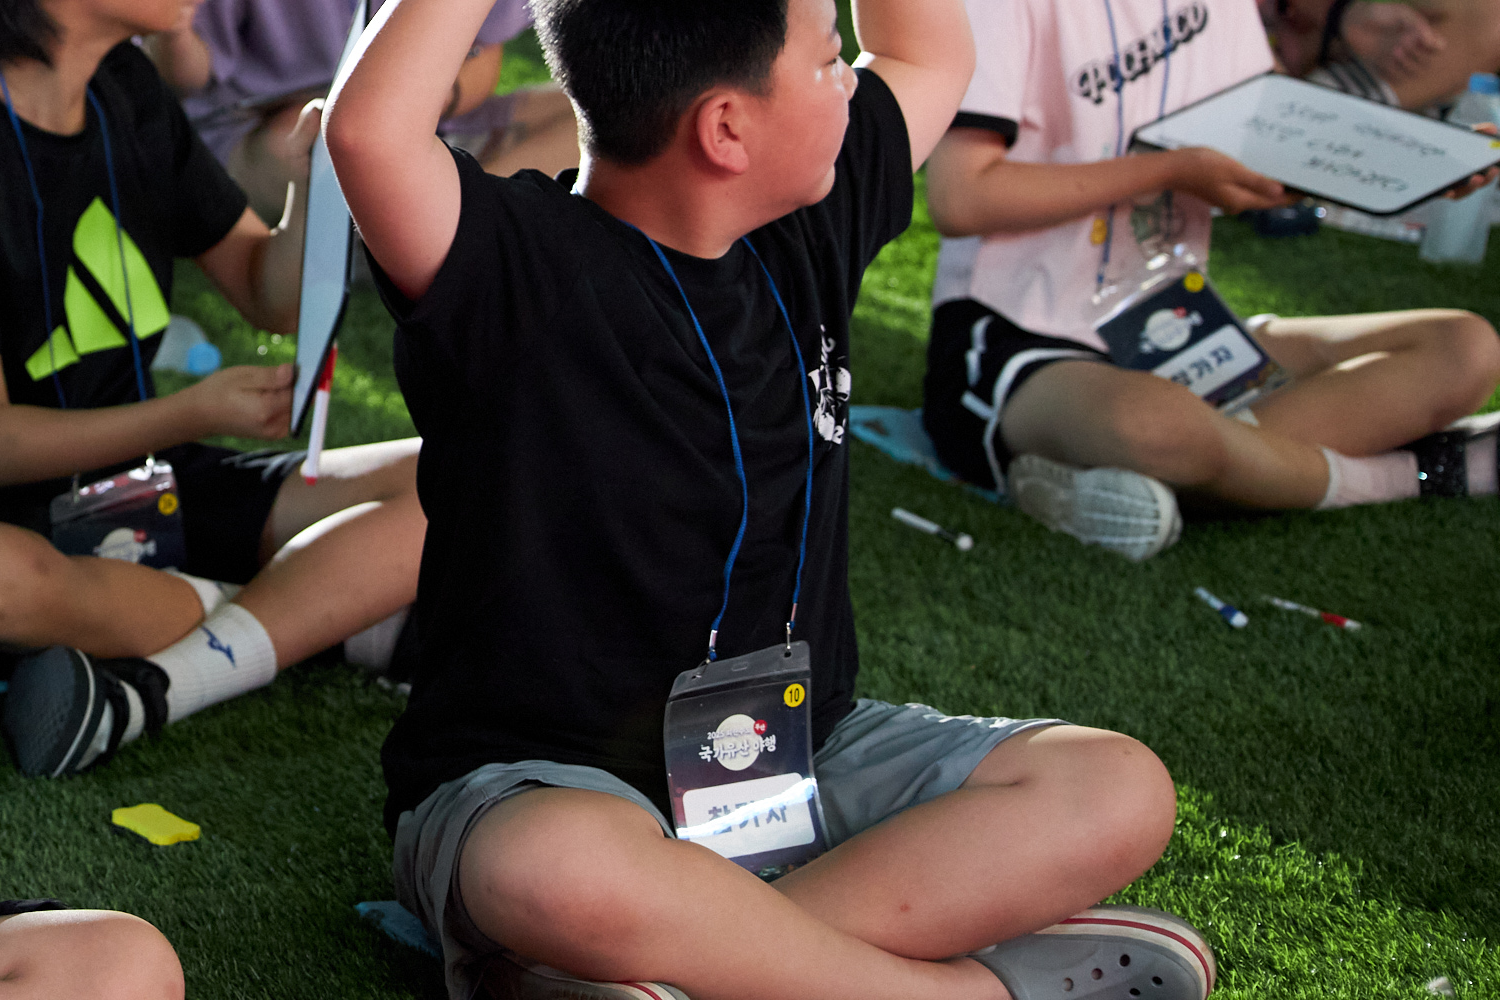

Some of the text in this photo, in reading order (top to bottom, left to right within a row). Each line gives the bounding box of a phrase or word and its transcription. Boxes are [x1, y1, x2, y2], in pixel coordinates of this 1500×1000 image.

[788, 687, 800, 704] 10
[698, 733, 777, 763] 국가유산 야행
